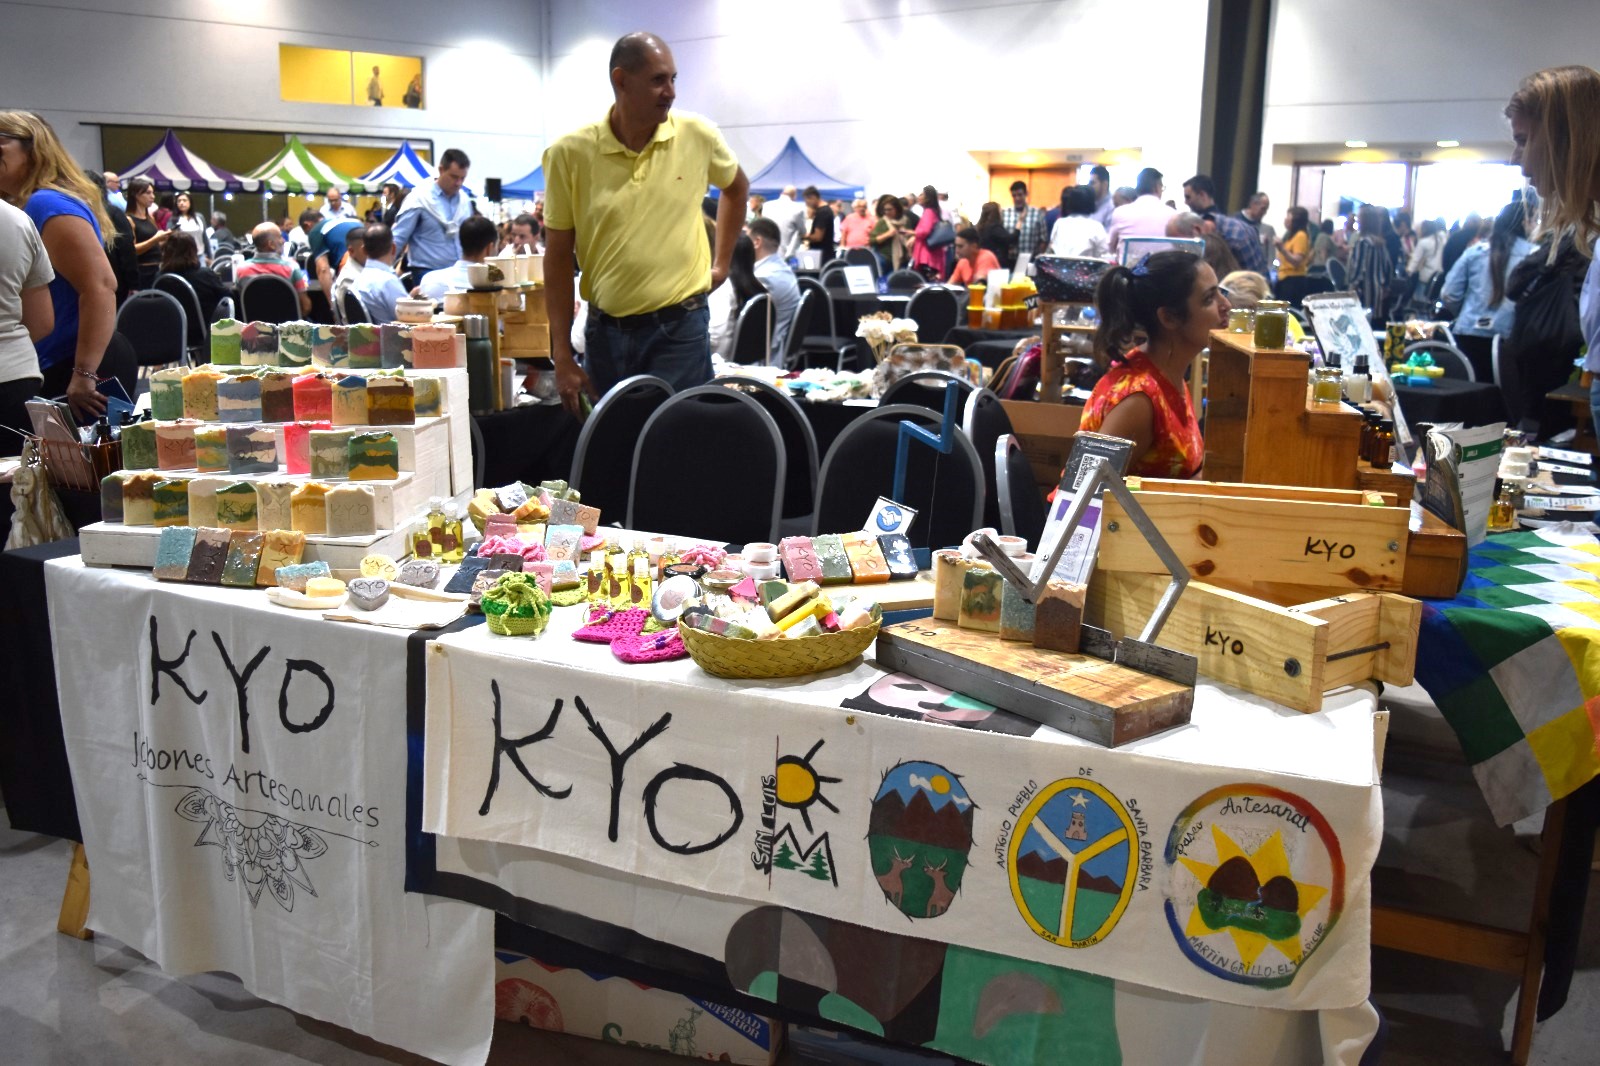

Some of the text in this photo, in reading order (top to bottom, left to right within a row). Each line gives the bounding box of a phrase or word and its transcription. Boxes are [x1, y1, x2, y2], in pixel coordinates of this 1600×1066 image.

[418, 341, 451, 357] KYO
[330, 502, 370, 521] KYO
[563, 506, 591, 522] KYO
[795, 546, 815, 573] KYO
[1303, 535, 1357, 563] KYO
[353, 581, 387, 593] KYO
[899, 623, 938, 637] KYO
[1204, 625, 1245, 656] KYO
[150, 615, 335, 754] KYO
[478, 677, 746, 856] KYO
[222, 763, 380, 828] Artesanales
[750, 774, 777, 873] SAN LUIS
[1008, 779, 1038, 818] PUEBLO
[1078, 767, 1094, 777] DE
[1125, 798, 1149, 838] SANTA
[1139, 840, 1154, 892] BARBARA
[1040, 930, 1058, 942] SAN
[701, 1000, 760, 1040] SUPERIOR
